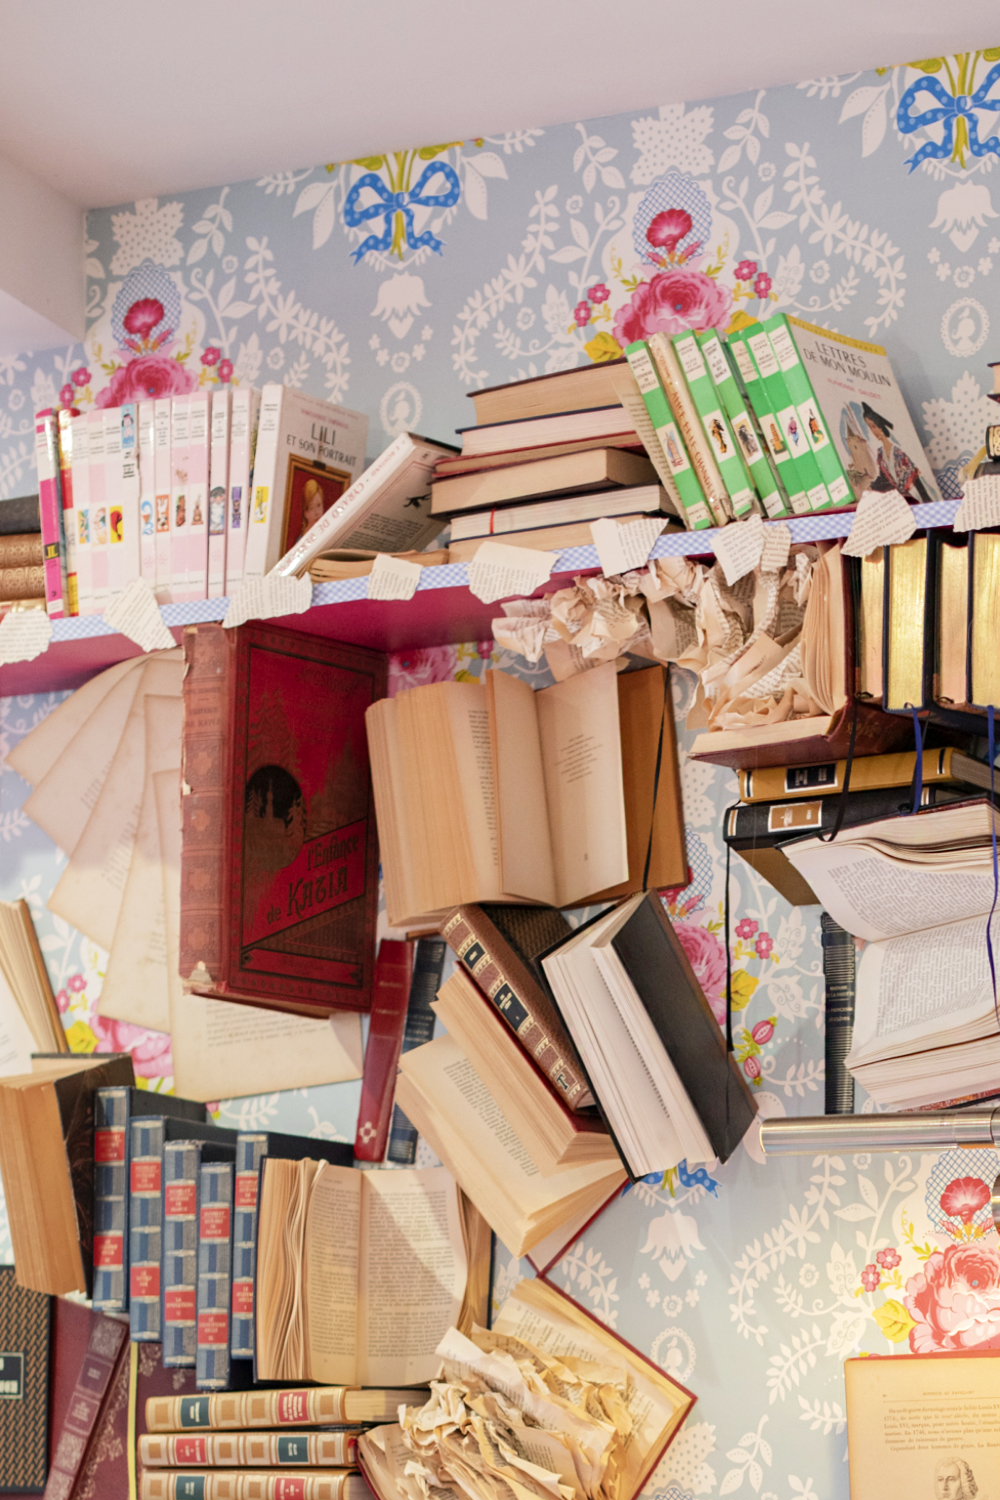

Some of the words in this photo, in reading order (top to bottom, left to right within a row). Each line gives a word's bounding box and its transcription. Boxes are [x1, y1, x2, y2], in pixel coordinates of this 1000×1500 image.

[803, 348, 818, 363] DE
[819, 355, 847, 374] MON
[847, 364, 892, 387] MOULIN
[815, 341, 867, 369] LETTRES
[311, 422, 337, 447] LILI
[286, 433, 296, 446] ET
[298, 438, 317, 453] SON
[318, 445, 358, 467] PORTRAIT
[266, 904, 282, 925] de
